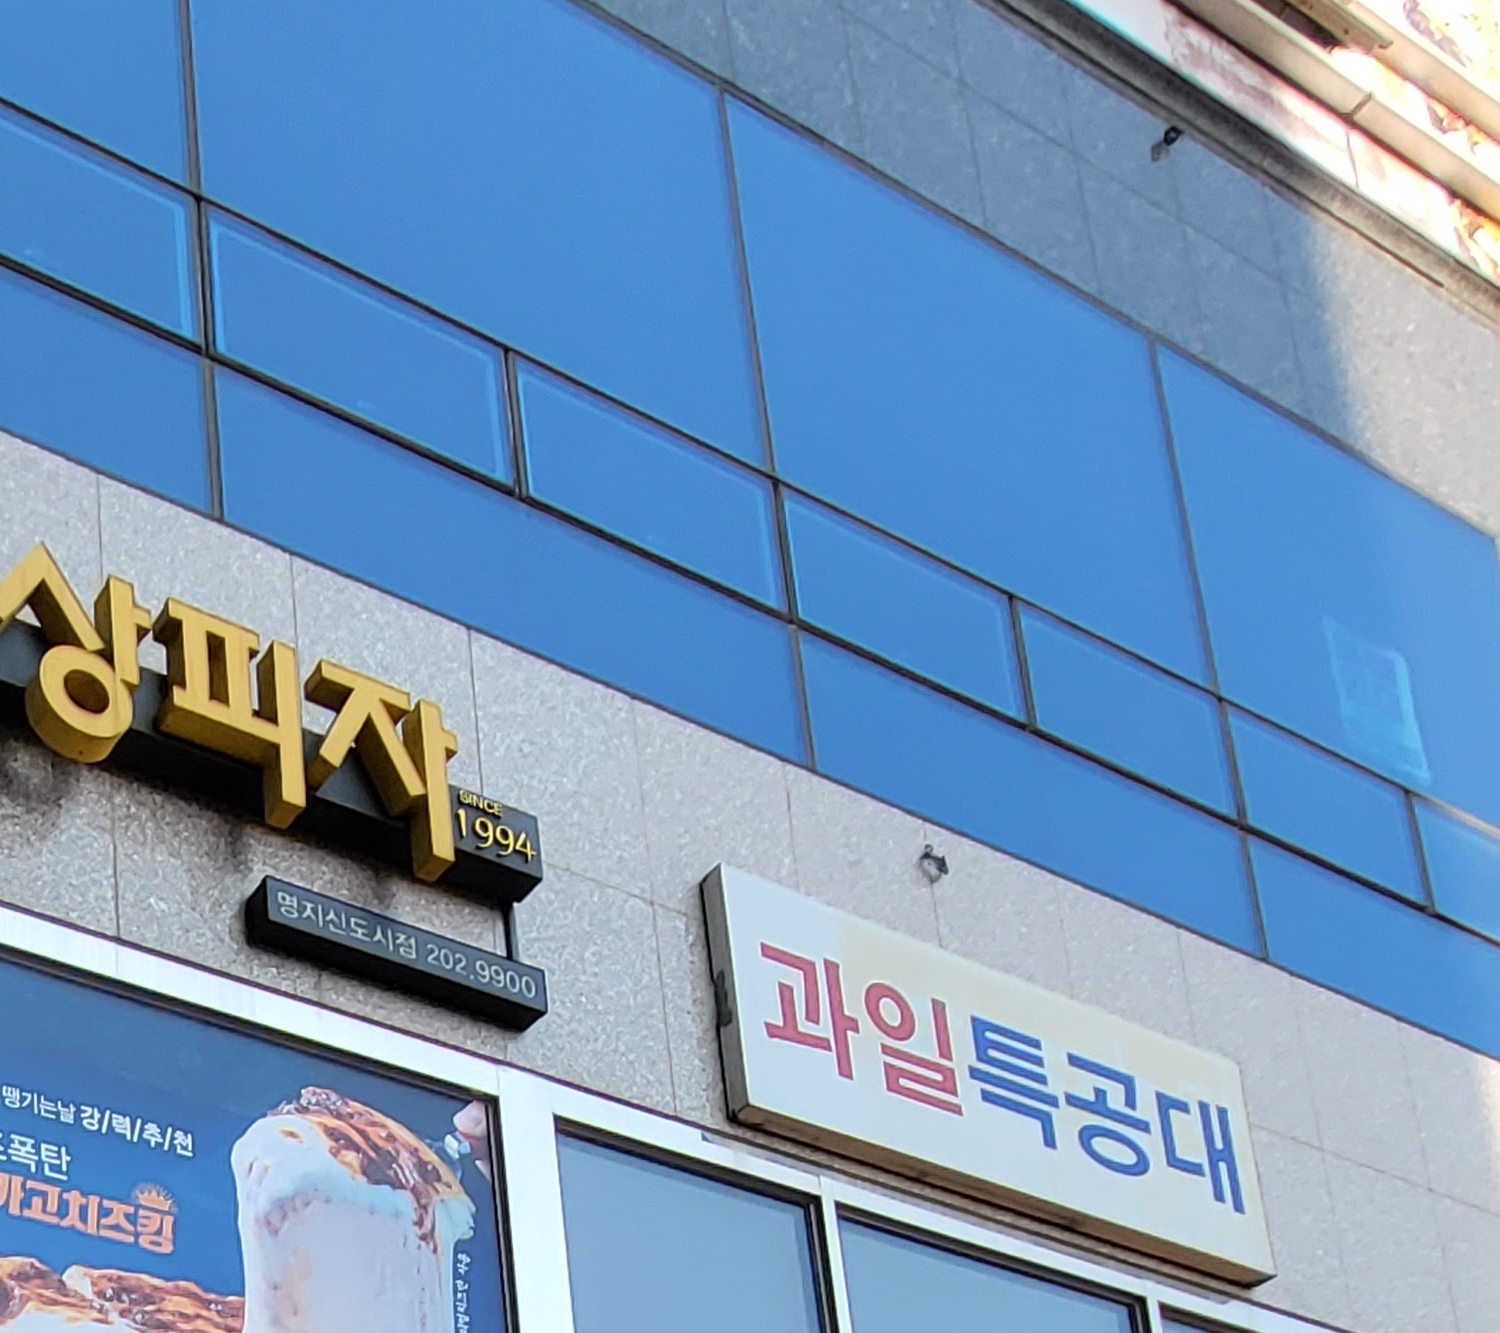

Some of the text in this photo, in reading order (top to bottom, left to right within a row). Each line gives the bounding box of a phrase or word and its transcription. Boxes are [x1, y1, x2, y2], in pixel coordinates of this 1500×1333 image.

[459, 788, 504, 818] SINCE
[457, 808, 536, 862] 1994
[276, 890, 537, 999] 명지신도시점 202.9900
[2, 1084, 76, 1125] 땡기는날
[758, 941, 1246, 1215] 과일특공대
